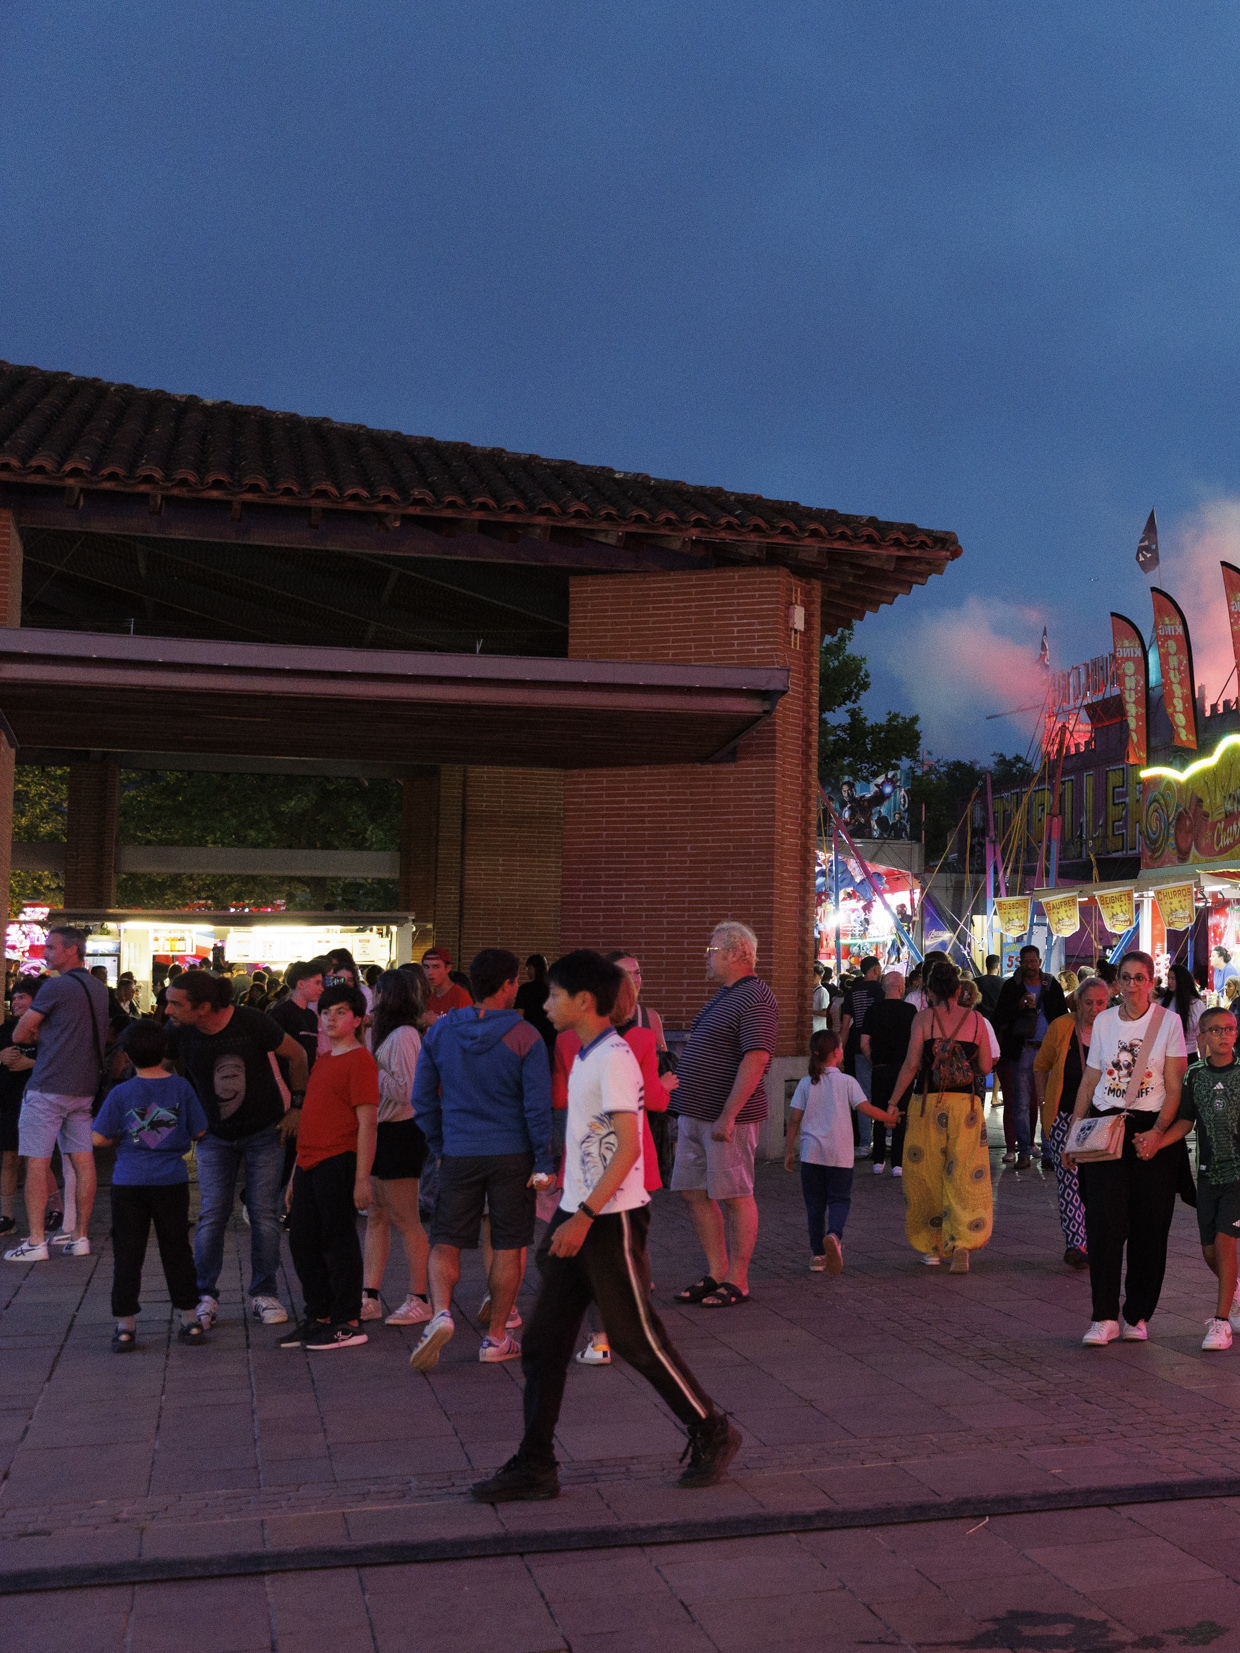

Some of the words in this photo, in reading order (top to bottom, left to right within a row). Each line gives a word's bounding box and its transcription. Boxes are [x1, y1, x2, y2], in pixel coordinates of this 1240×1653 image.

[1099, 892, 1132, 906] BEIGNETS
[1156, 887, 1192, 902] CHURROS
[998, 901, 1027, 911] BOISSONS
[1045, 898, 1076, 911] GAUFRES
